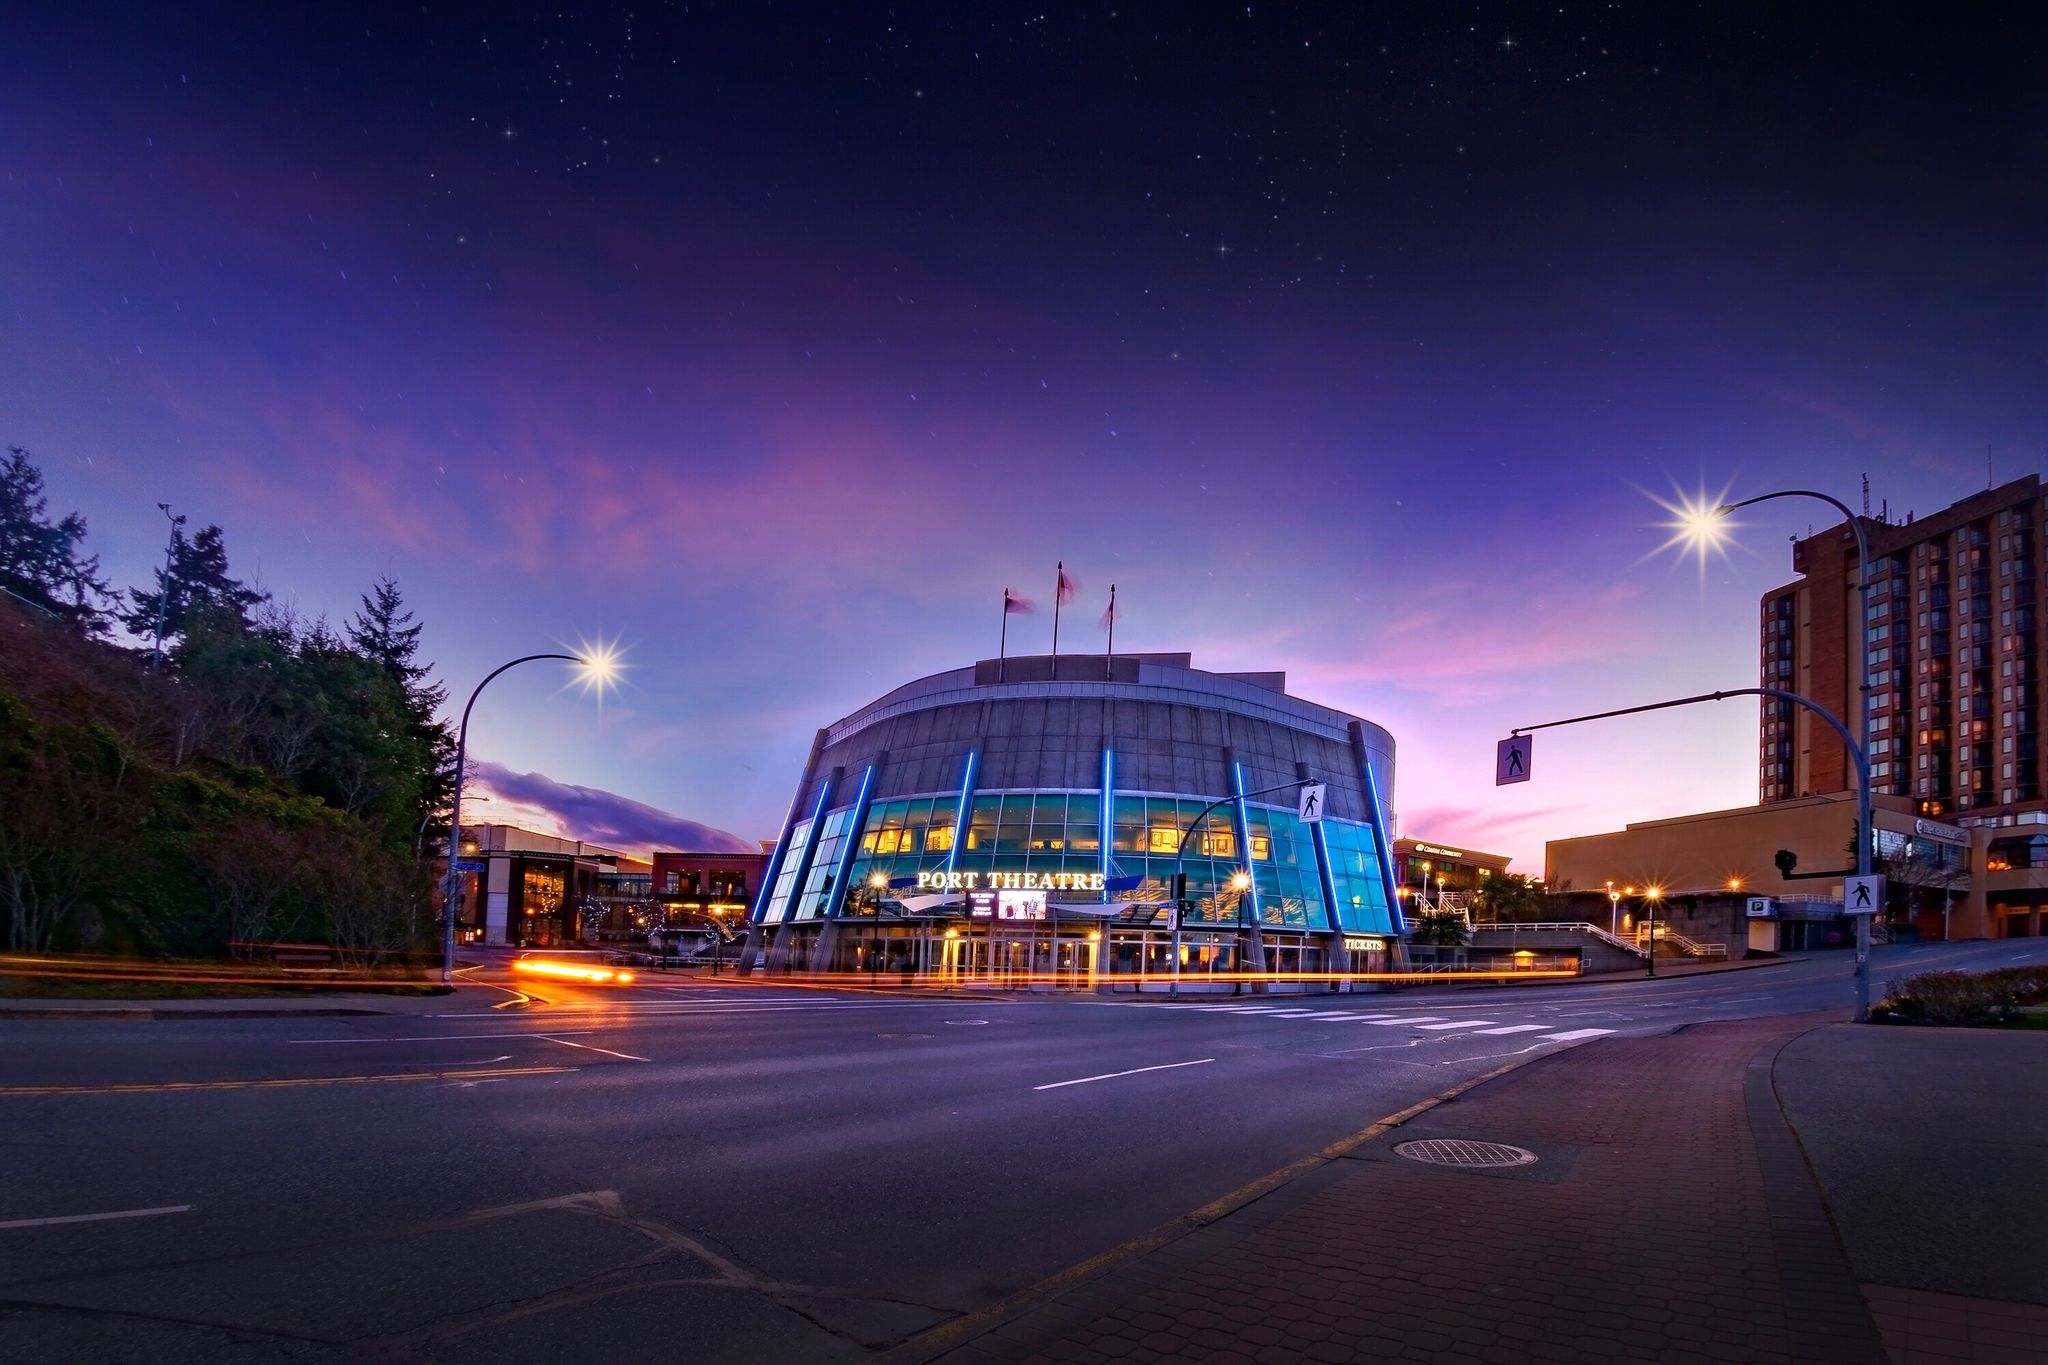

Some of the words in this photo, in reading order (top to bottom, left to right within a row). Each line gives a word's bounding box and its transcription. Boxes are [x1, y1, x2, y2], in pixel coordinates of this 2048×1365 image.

[917, 872, 978, 889] PORT
[987, 873, 1105, 890] THEATRE
[1344, 939, 1383, 950] TICKETS
